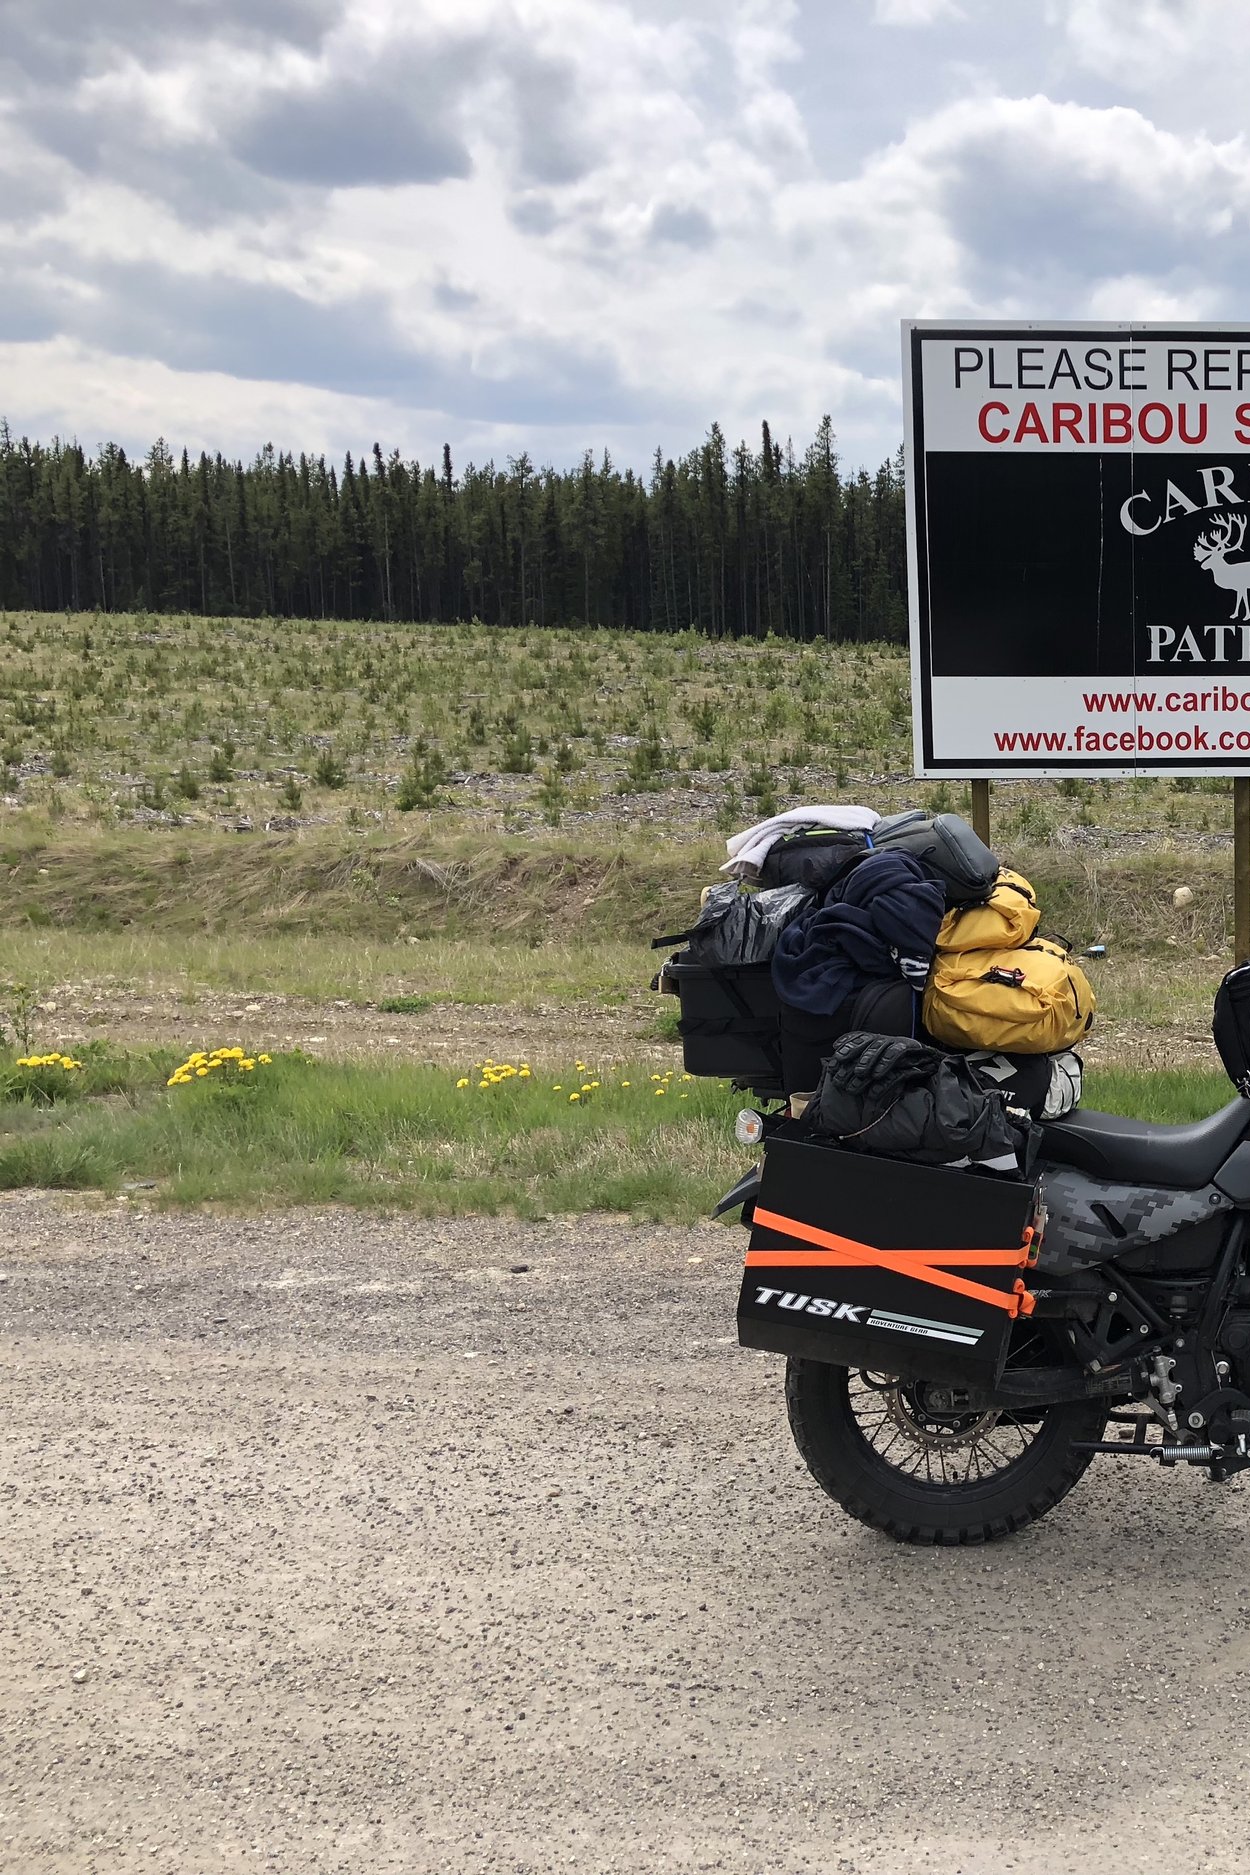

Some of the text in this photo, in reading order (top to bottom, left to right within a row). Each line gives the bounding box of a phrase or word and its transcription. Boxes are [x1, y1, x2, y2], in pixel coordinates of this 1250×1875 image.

[955, 348, 1147, 390] PLEASE
[979, 402, 1207, 444] CARIBOU
[755, 1286, 872, 1324] TUSK
